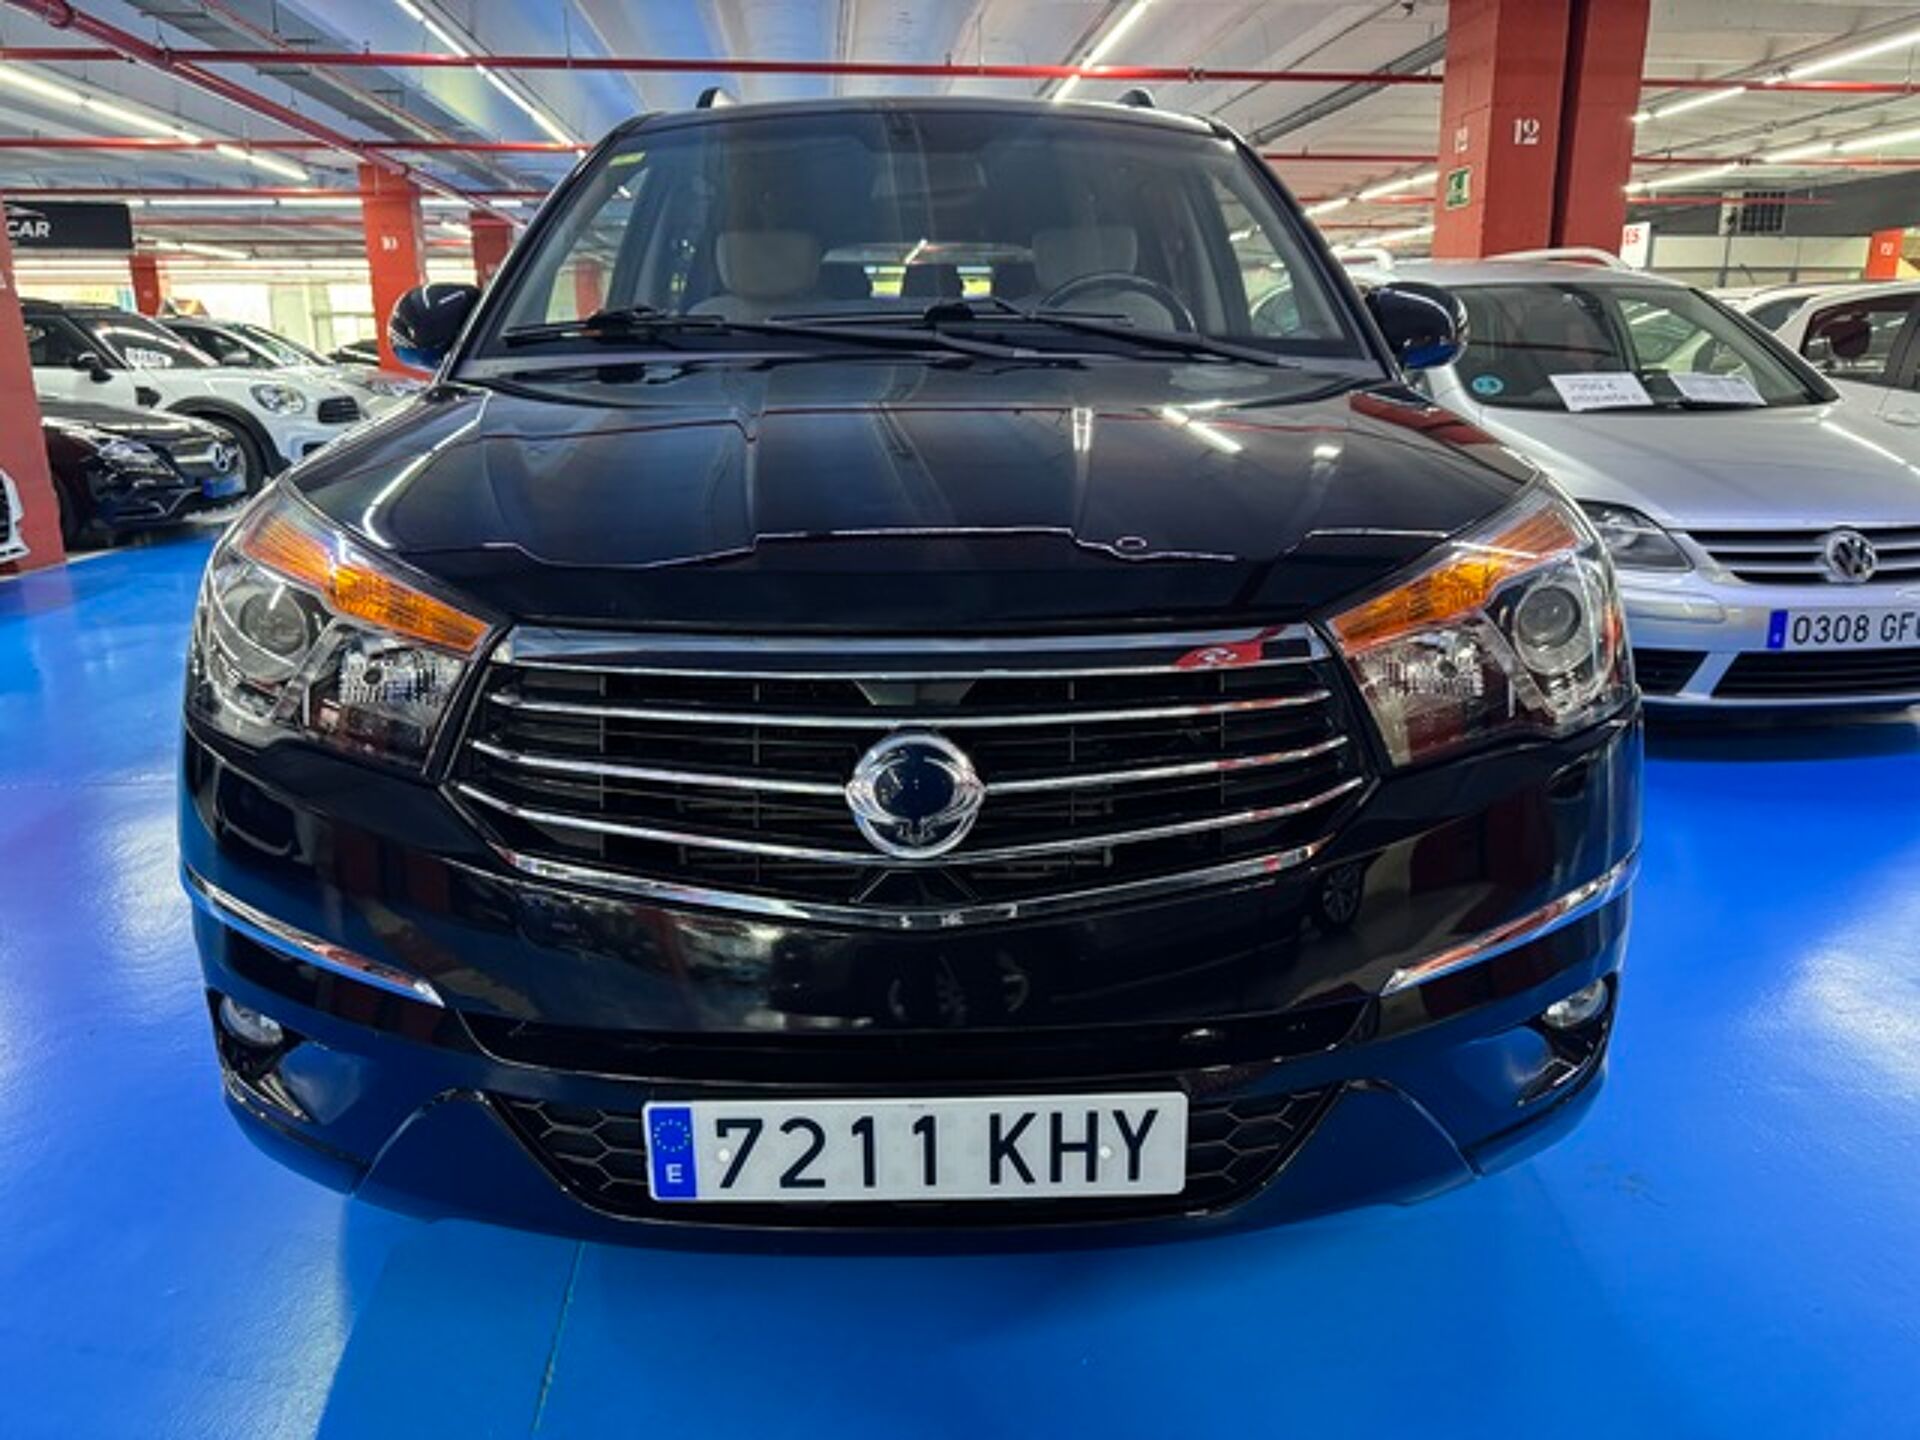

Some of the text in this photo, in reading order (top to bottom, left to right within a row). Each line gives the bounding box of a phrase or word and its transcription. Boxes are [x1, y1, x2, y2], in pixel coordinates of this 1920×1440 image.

[1514, 118, 1540, 145] 12
[6, 220, 51, 238] CAR
[1792, 614, 1870, 645] 0308
[1879, 611, 1920, 643] GF
[715, 1108, 1159, 1189] 7211 KHY
[665, 1163, 683, 1183] E
